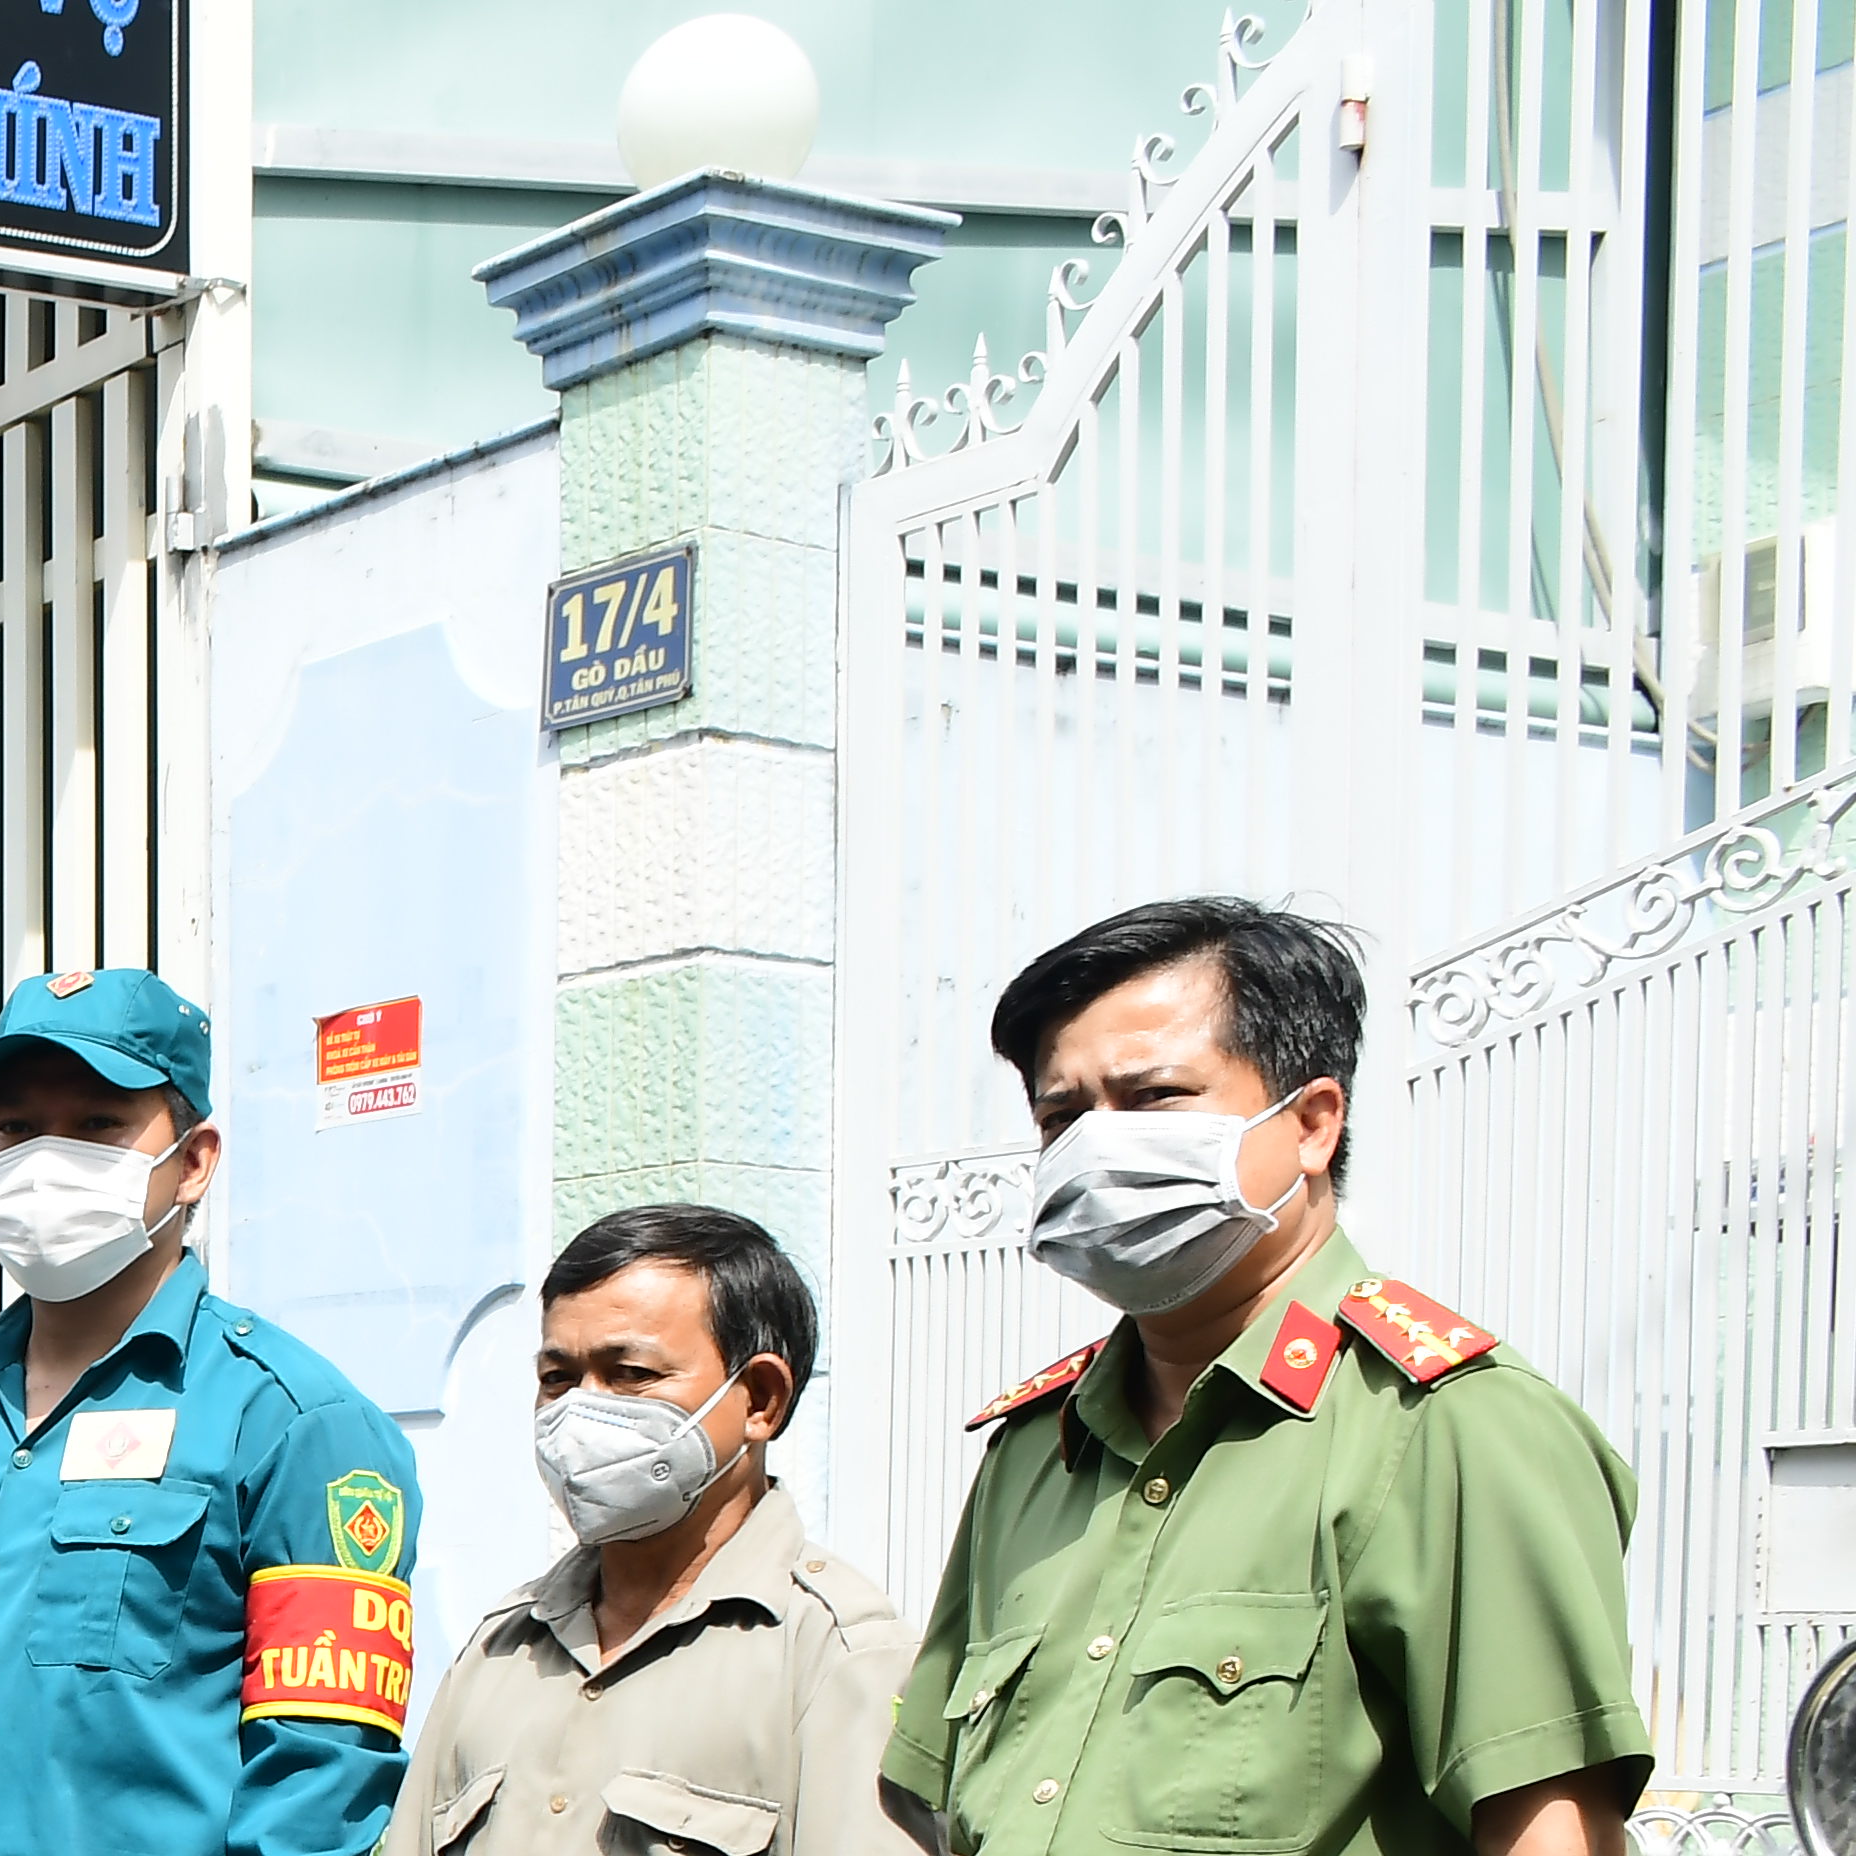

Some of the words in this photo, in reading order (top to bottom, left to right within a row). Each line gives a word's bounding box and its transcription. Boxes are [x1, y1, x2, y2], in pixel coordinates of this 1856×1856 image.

[560, 566, 679, 664] 17/4
[571, 660, 606, 690] GÒ
[261, 1629, 367, 1692] TUẦN
